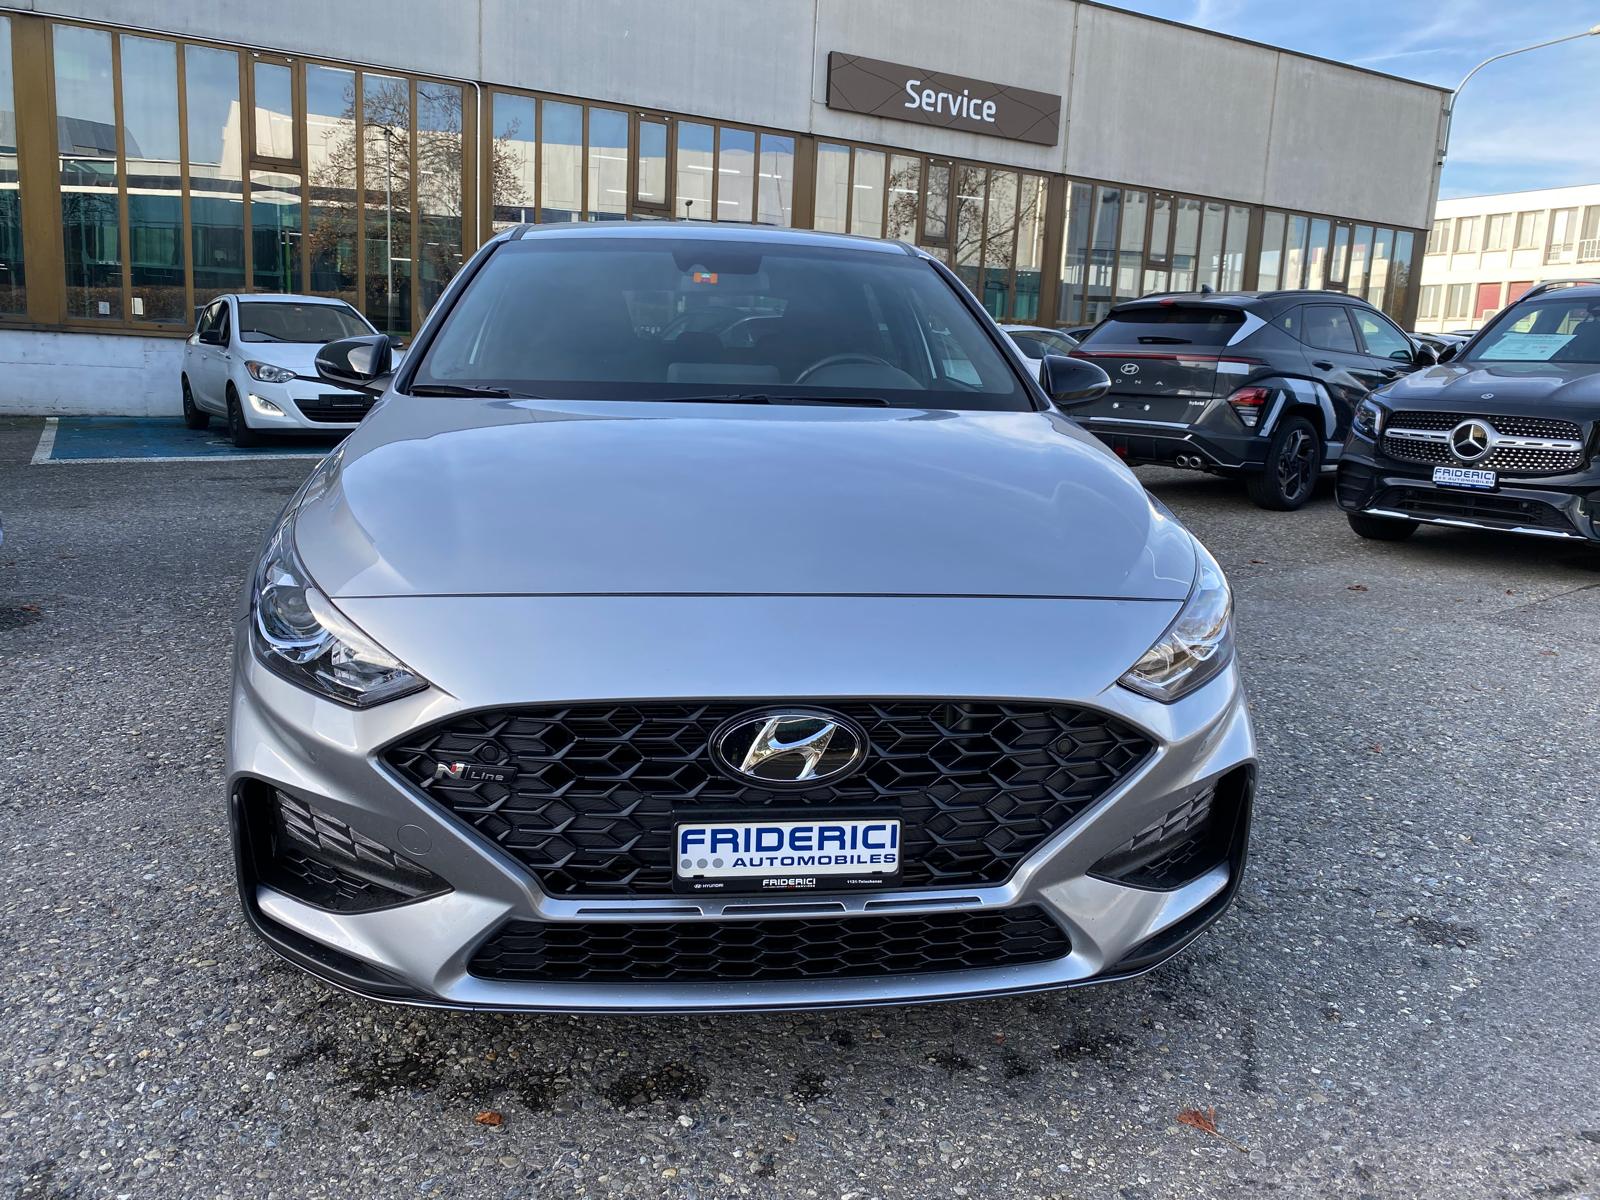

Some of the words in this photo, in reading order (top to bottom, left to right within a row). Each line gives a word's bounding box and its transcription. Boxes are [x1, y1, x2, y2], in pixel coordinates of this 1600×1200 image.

[904, 79, 996, 122] Service
[1434, 468, 1495, 481] FRIDERICI
[470, 771, 505, 781] Line
[680, 824, 898, 855] FRIDERICI
[732, 853, 896, 868] AUTOMOBILES
[762, 878, 816, 886] FRIDERICI
